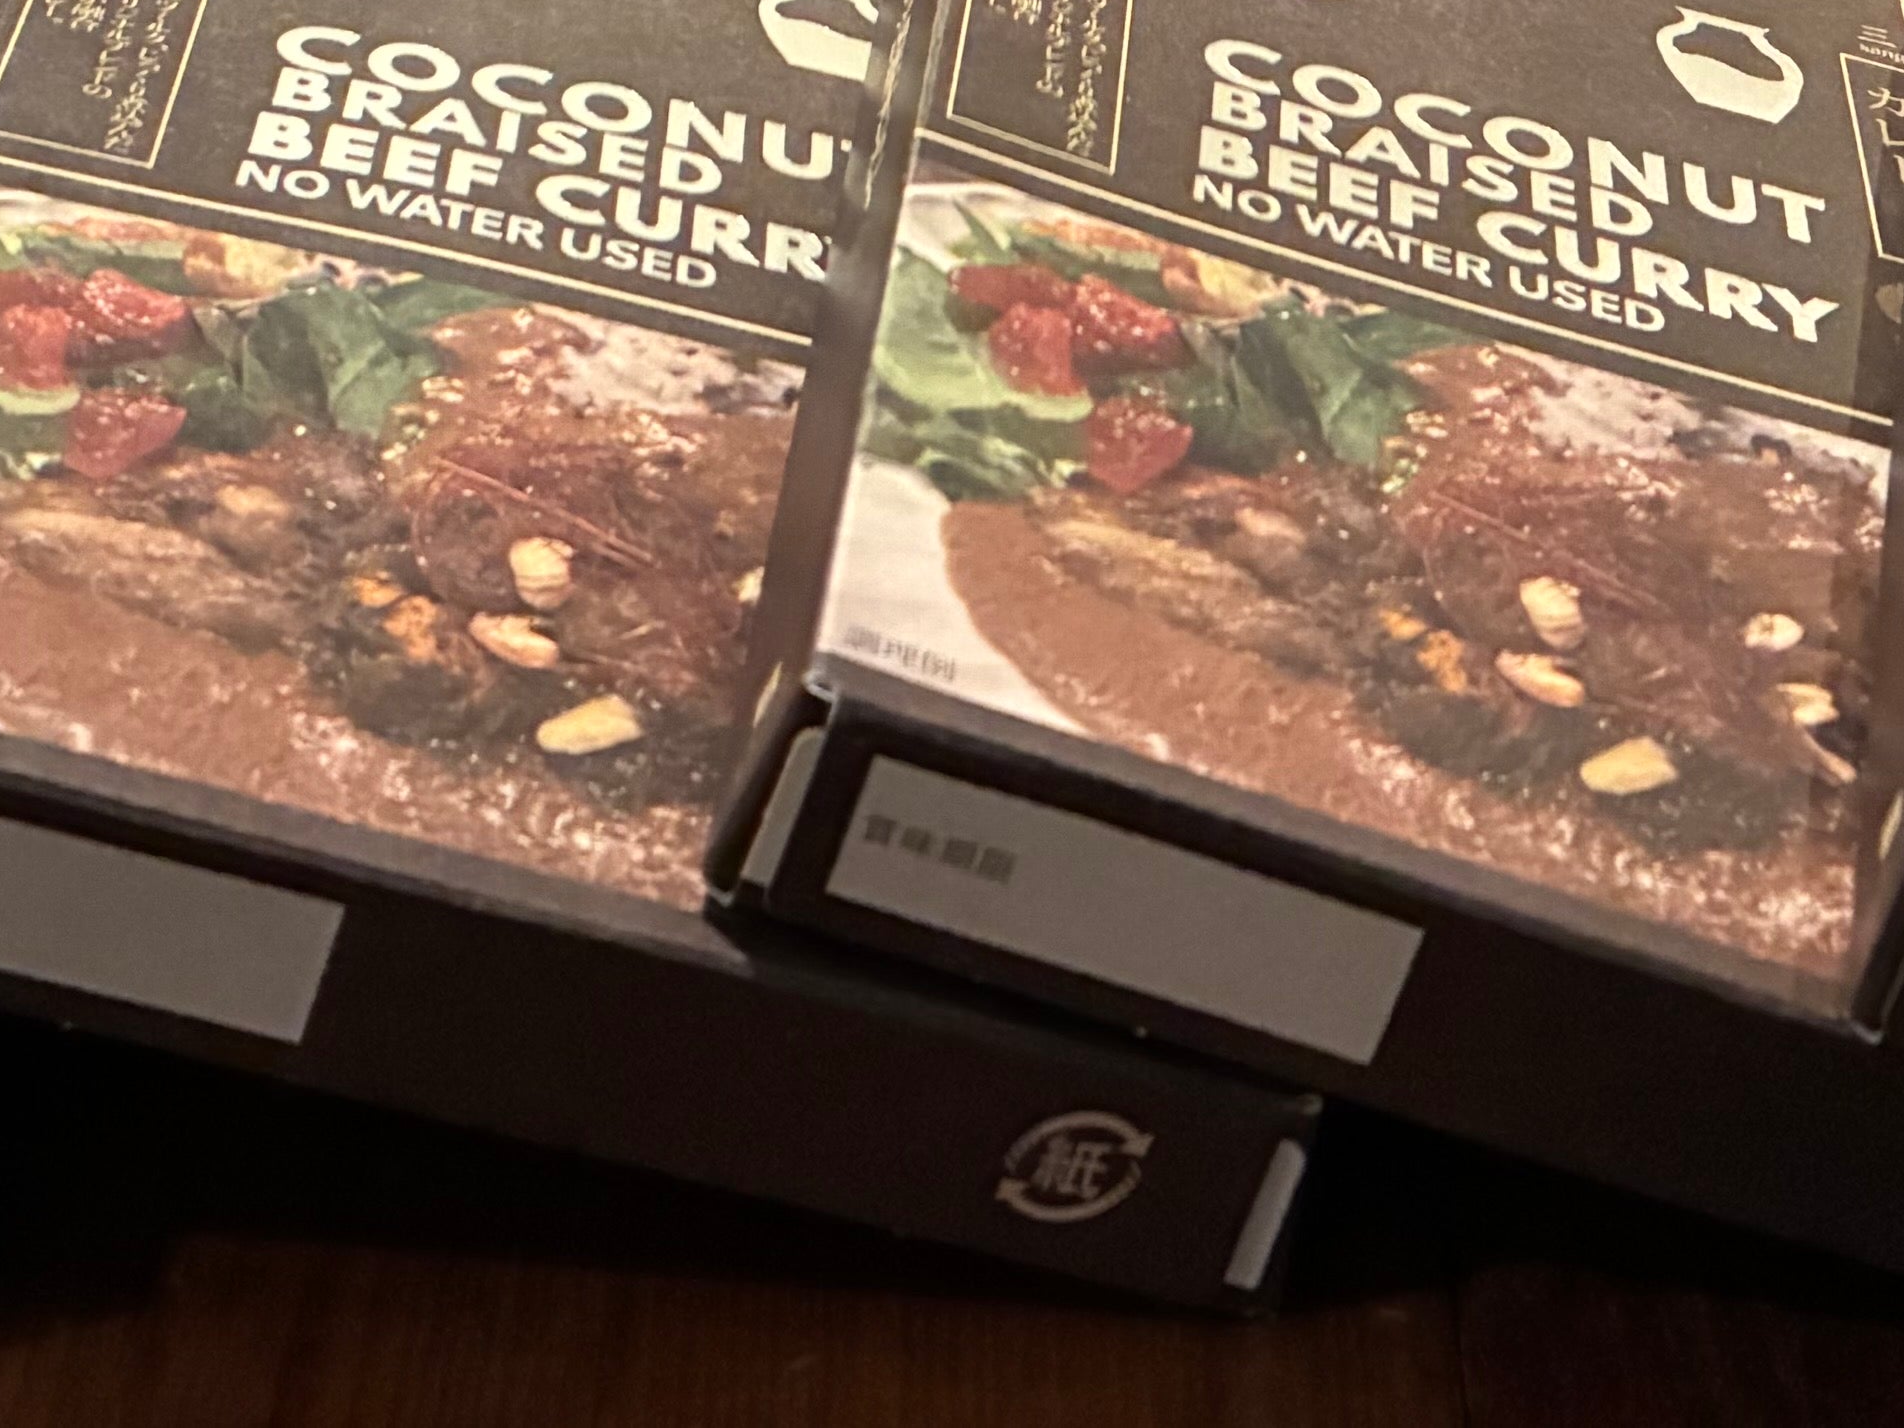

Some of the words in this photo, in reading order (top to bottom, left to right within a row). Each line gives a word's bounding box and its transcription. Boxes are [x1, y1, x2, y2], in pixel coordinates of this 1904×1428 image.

[272, 65, 722, 193] BRAISED
[276, 26, 852, 180] COCONU
[1205, 40, 1825, 243] COCONUT
[1212, 82, 1653, 235] BRAISED
[236, 160, 329, 199] NO
[346, 179, 543, 249] WATER
[561, 228, 716, 287] USED
[248, 111, 502, 195] BEEF
[536, 175, 832, 281] CURR
[1193, 175, 1281, 221] NO
[1297, 204, 1492, 287] WATER
[1510, 266, 1665, 331] USED
[1199, 126, 1439, 228] BEEF
[1477, 212, 1839, 342] CURRY
